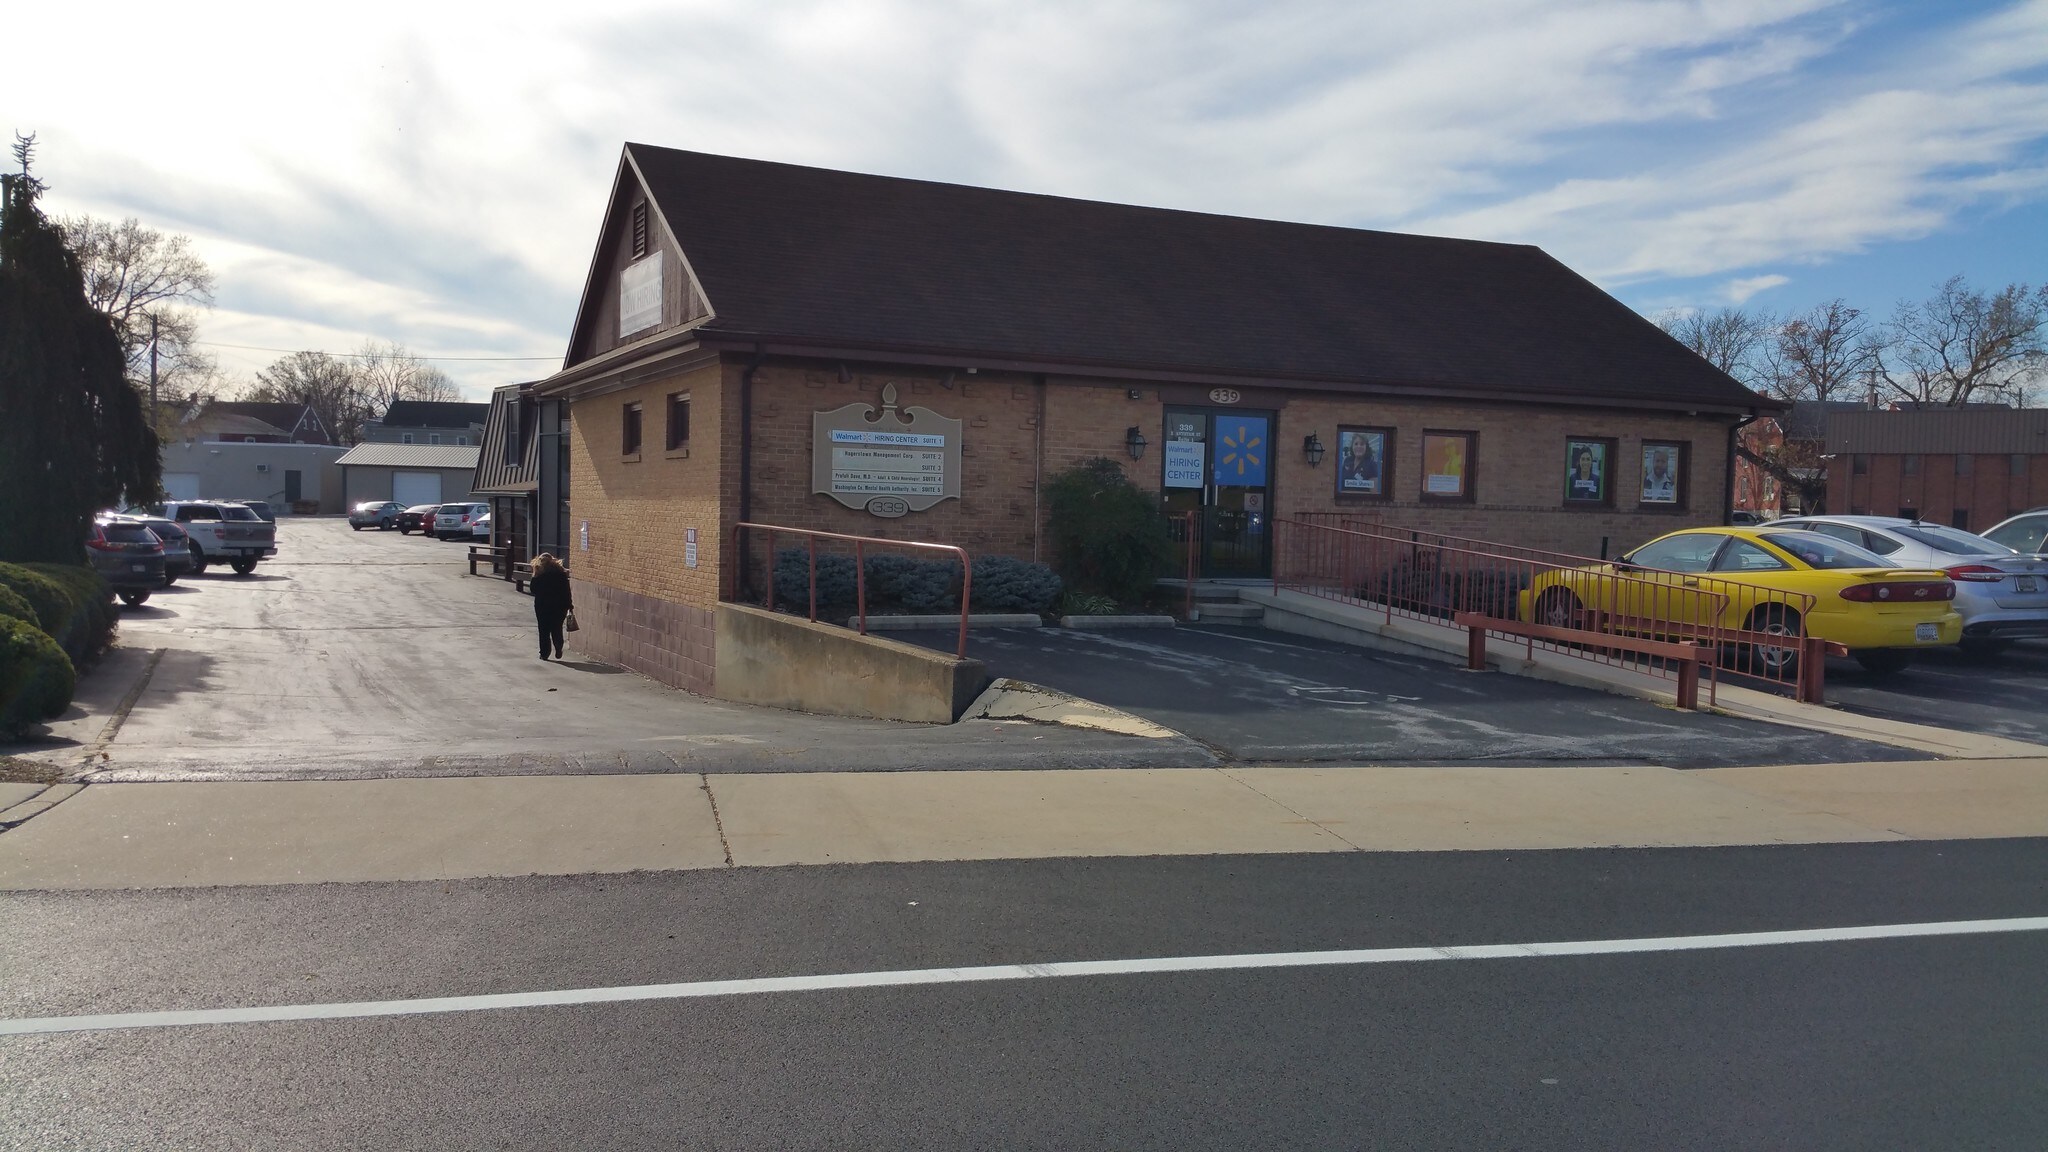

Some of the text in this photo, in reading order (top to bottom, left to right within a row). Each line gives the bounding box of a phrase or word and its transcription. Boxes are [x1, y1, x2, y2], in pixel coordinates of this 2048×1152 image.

[1213, 389, 1238, 402] 339
[1179, 423, 1194, 431] 339
[835, 433, 862, 441] Walmart
[874, 434, 894, 442] HIRING
[895, 435, 919, 444] CENTER
[1168, 445, 1193, 454] Walmart
[1169, 458, 1200, 467] HIRING
[1167, 470, 1201, 480] CENTER
[872, 501, 904, 513] 339
